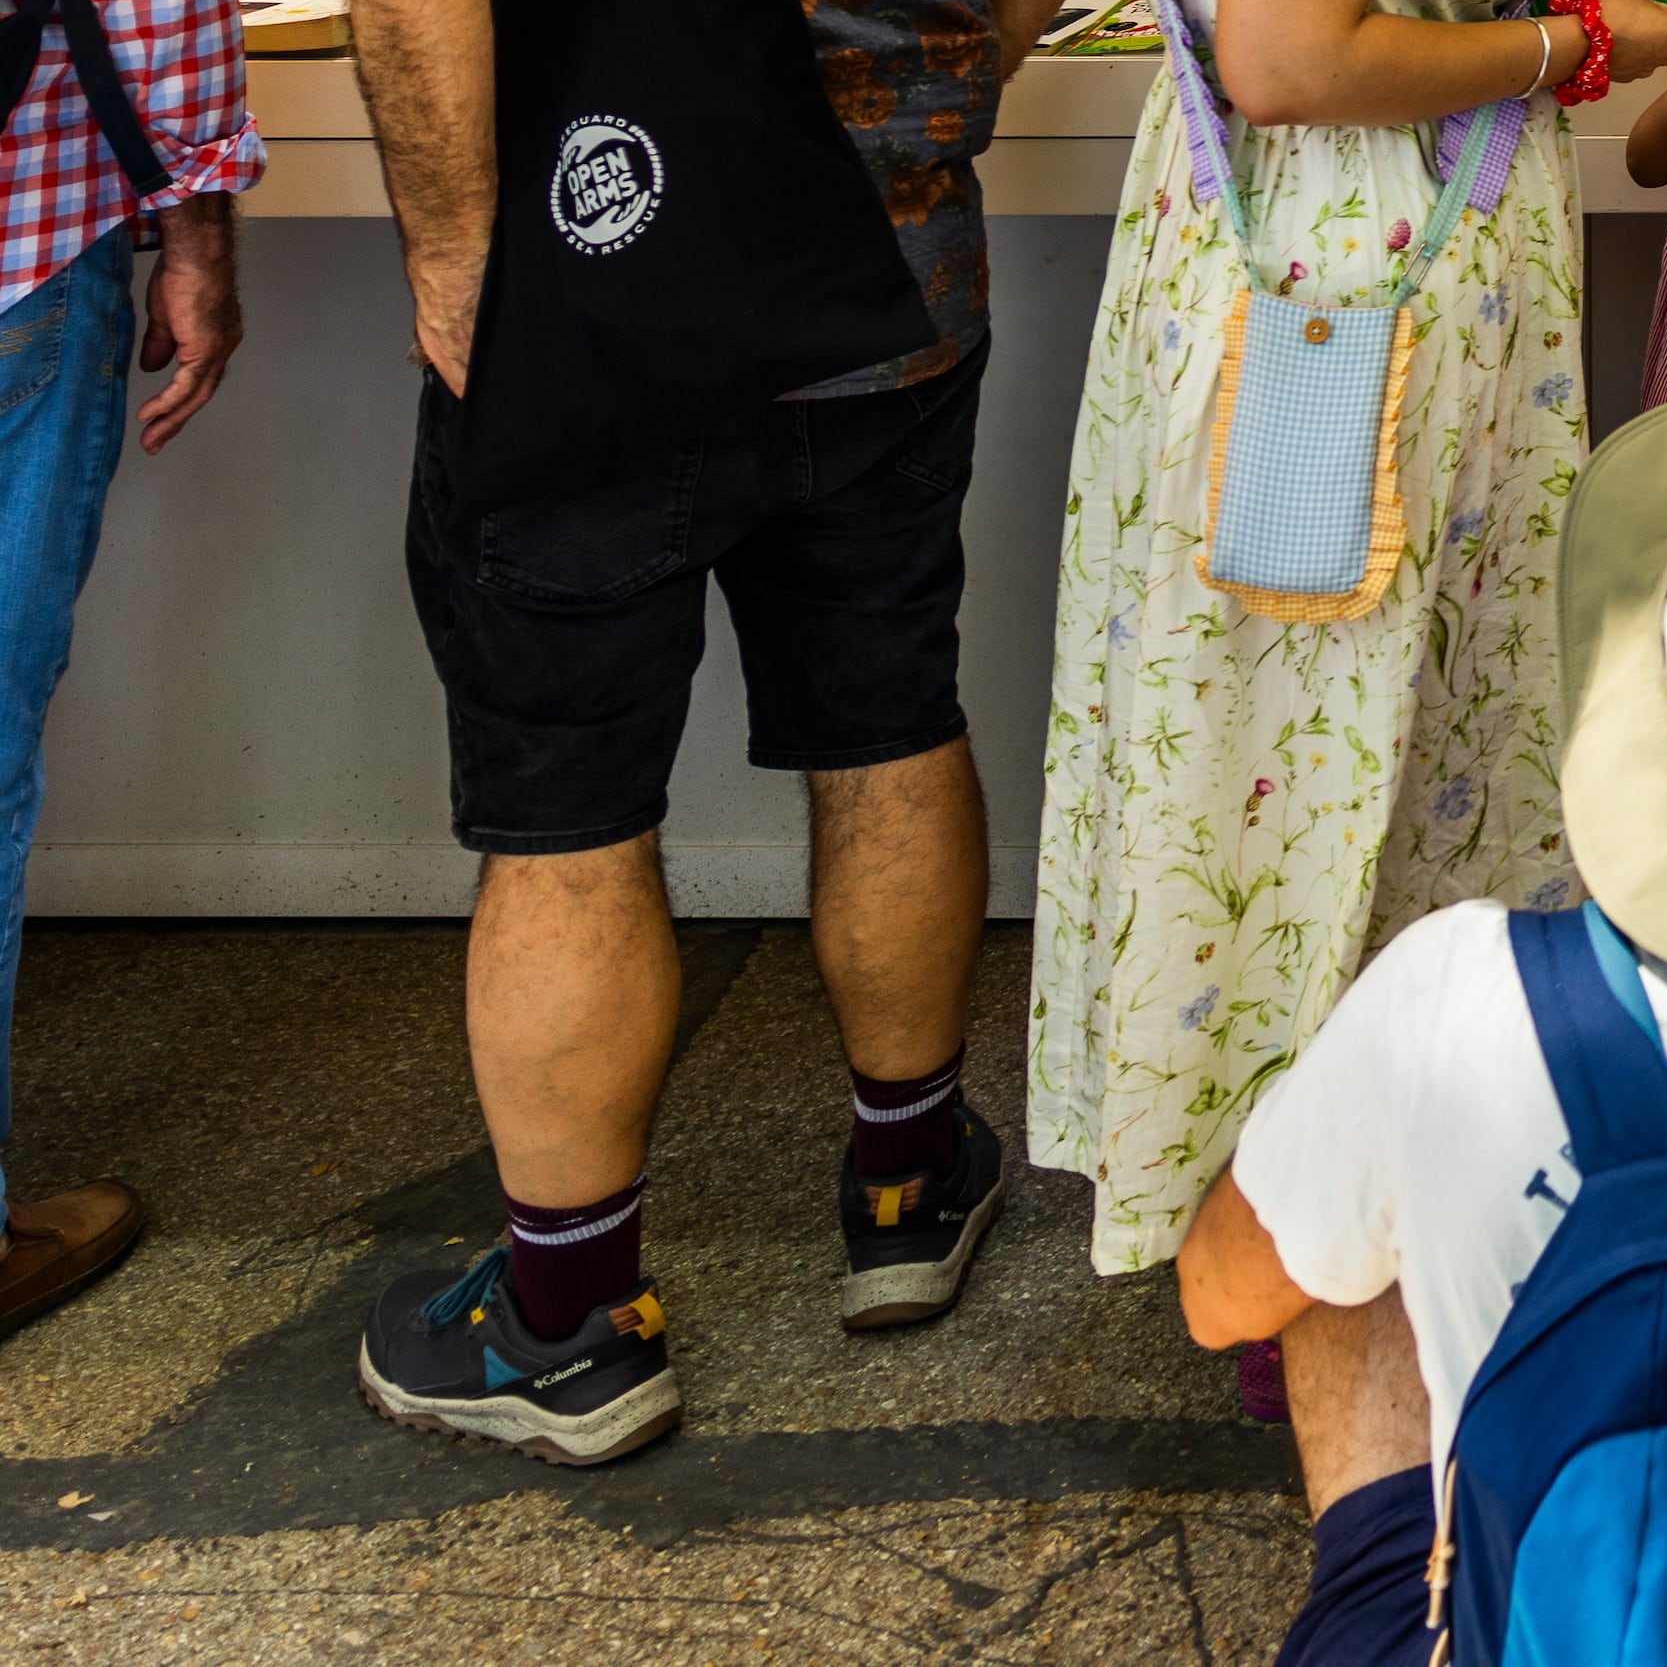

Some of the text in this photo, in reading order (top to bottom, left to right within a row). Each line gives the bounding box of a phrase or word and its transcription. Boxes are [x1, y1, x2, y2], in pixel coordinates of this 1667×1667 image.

[567, 147, 631, 195] OPEN
[574, 172, 638, 220] ARMS
[566, 198, 662, 255] SEA RESCUE
[542, 1359, 594, 1386] Columbia
